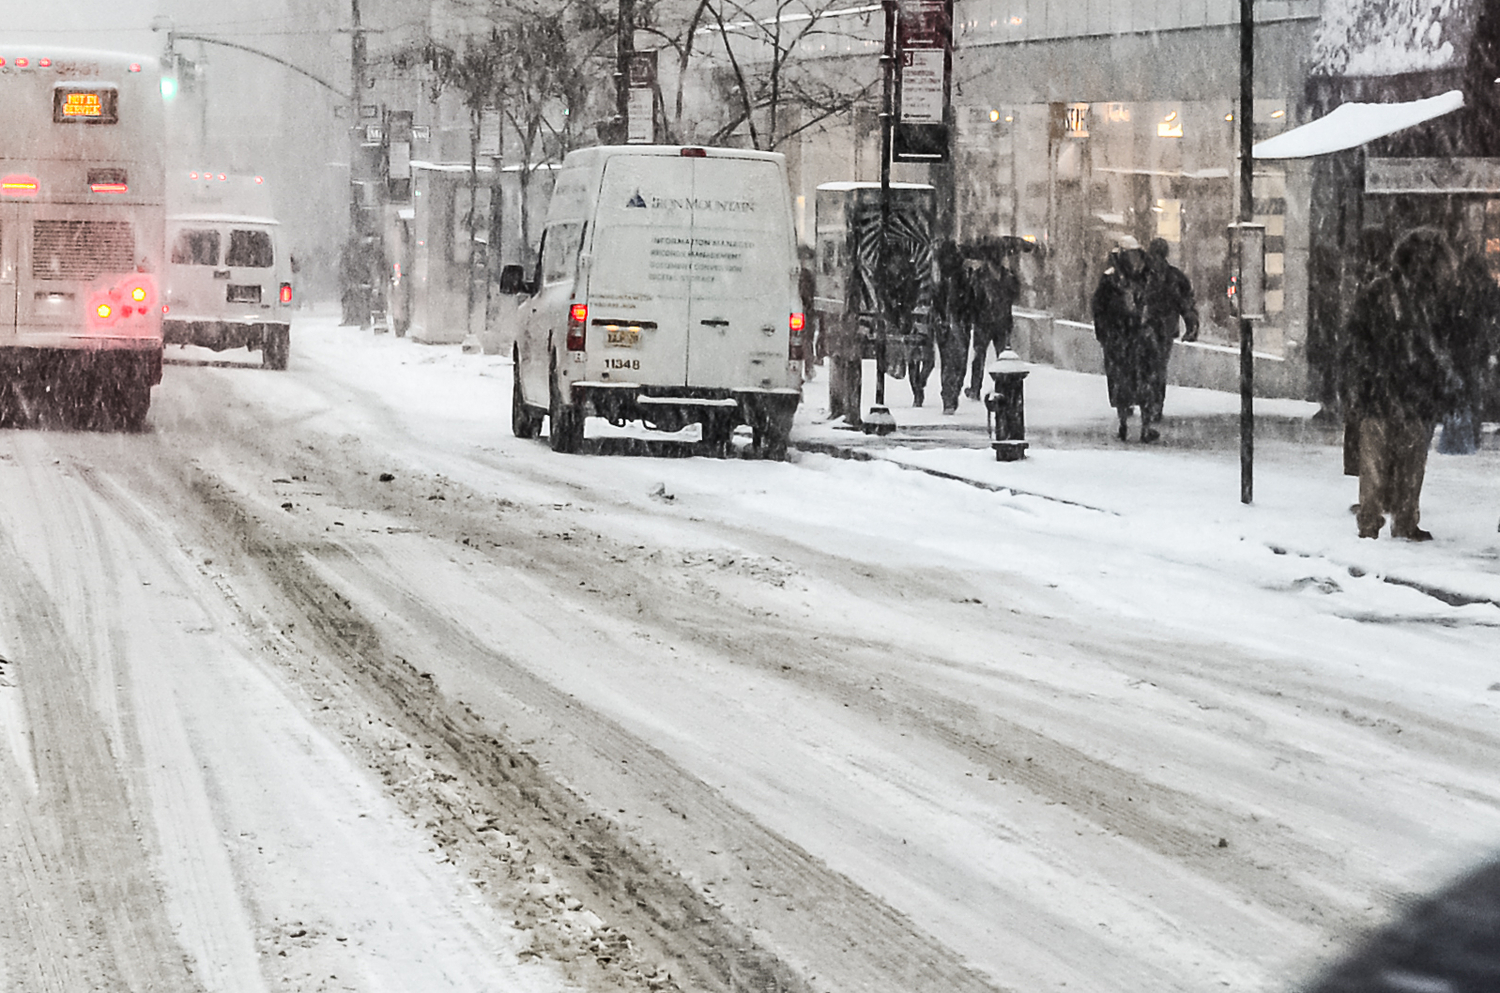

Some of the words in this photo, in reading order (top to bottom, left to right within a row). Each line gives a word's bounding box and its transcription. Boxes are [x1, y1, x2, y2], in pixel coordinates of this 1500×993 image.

[904, 52, 912, 66] 3
[67, 93, 84, 104] NOT
[86, 93, 98, 104] IN
[63, 104, 101, 115] SERVICE
[652, 196, 683, 209] IRON
[685, 197, 755, 212] MOUNTAIN
[604, 358, 640, 370] 11348
